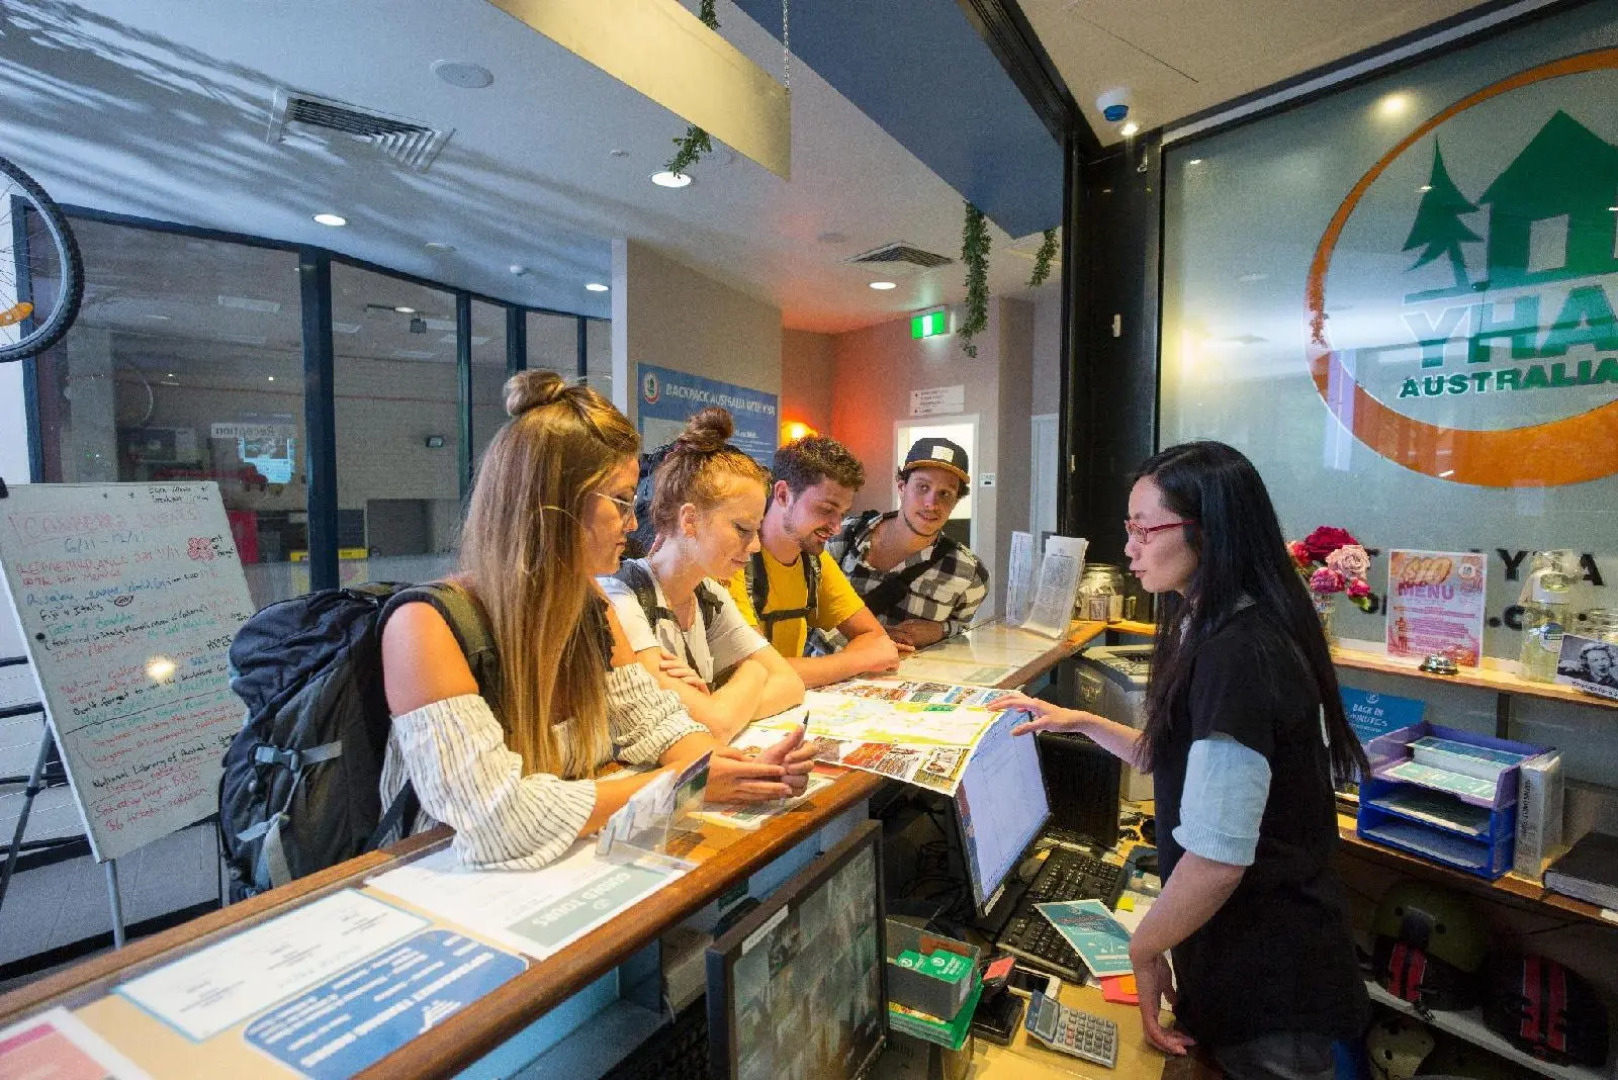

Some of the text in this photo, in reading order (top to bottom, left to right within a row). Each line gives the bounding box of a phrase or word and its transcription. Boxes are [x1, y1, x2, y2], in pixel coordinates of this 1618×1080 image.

[1403, 284, 1618, 369] YHA
[1399, 357, 1618, 399] AUSTRALIA
[665, 383, 709, 402] BACKPACK
[711, 393, 745, 408] AUSTRALIA
[1398, 583, 1454, 600] MENU
[1353, 703, 1373, 714] BACK
